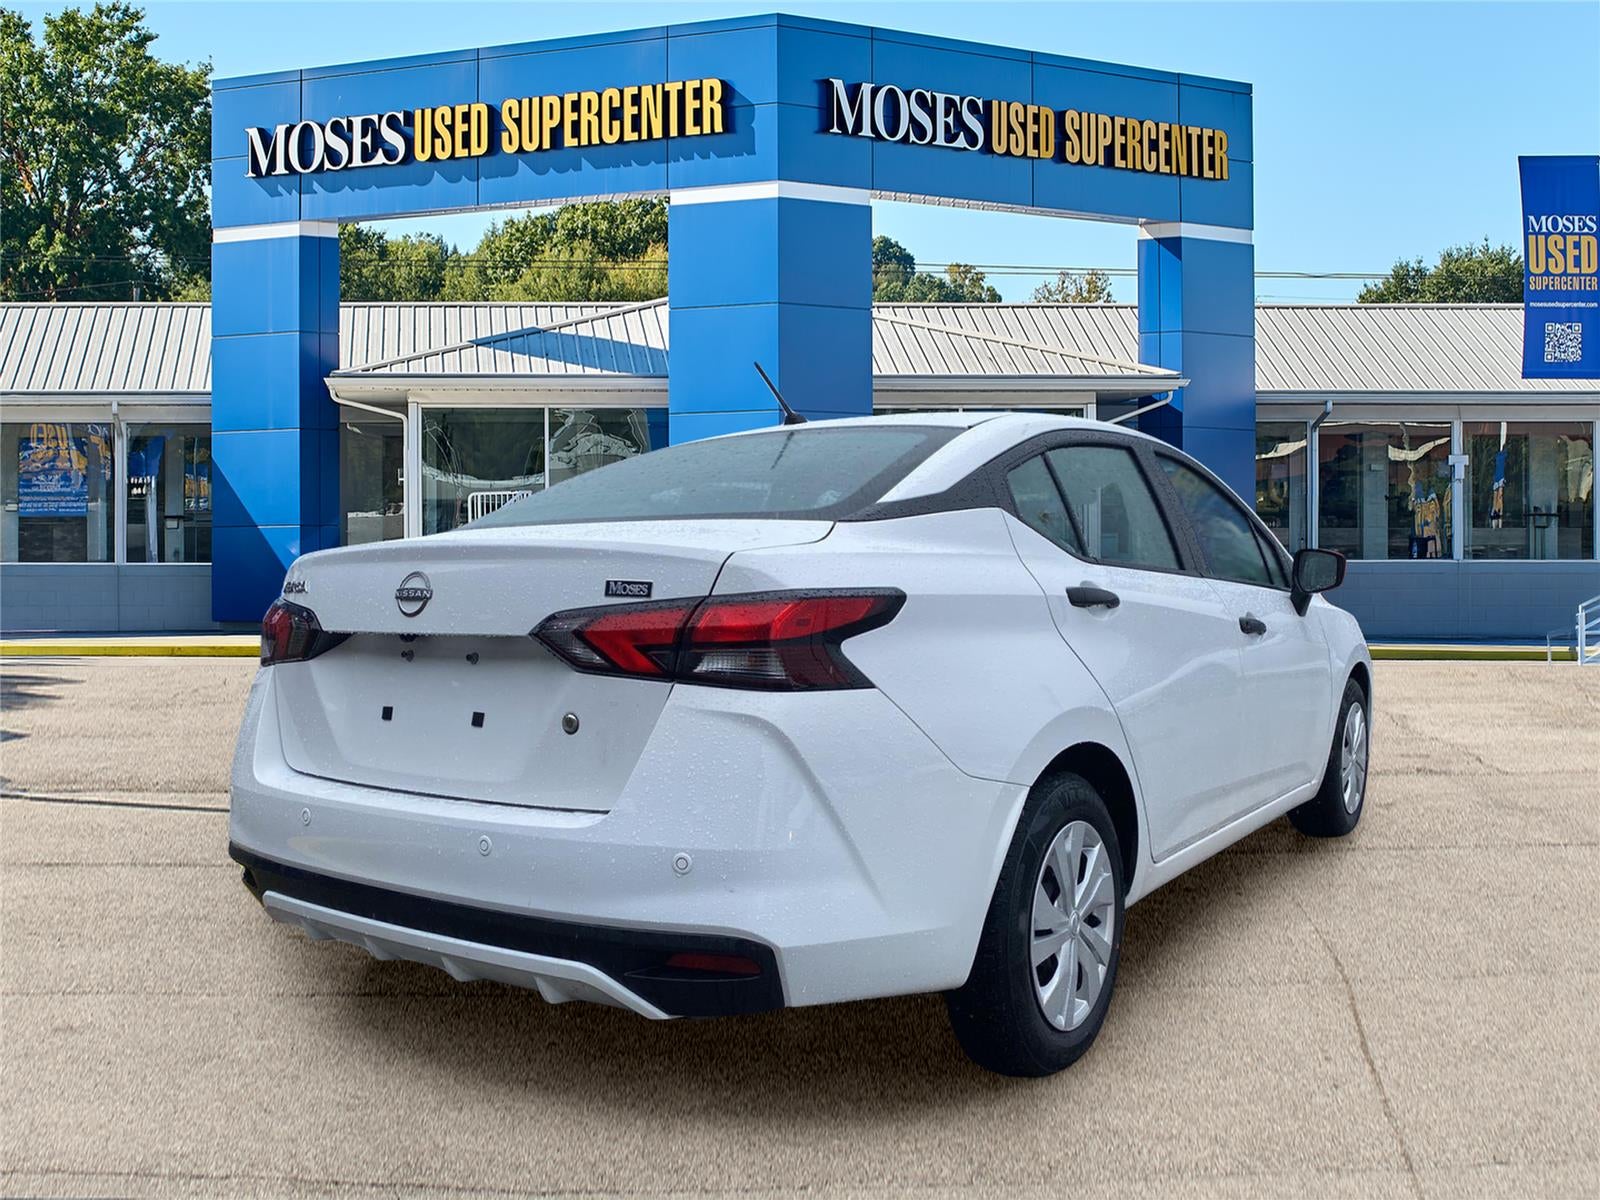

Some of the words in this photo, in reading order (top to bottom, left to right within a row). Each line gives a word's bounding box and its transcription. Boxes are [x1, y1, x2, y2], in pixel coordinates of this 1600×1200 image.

[245, 112, 407, 178] MOSES
[413, 103, 489, 162] USED
[501, 78, 724, 154] SUPERCENTER
[829, 78, 985, 152] MOSES
[991, 99, 1055, 160] USED
[1065, 109, 1230, 181] SUPERCENTER
[1528, 215, 1597, 233] MOSES
[1528, 234, 1598, 274] USED
[1529, 276, 1598, 291] SUPERCENTER
